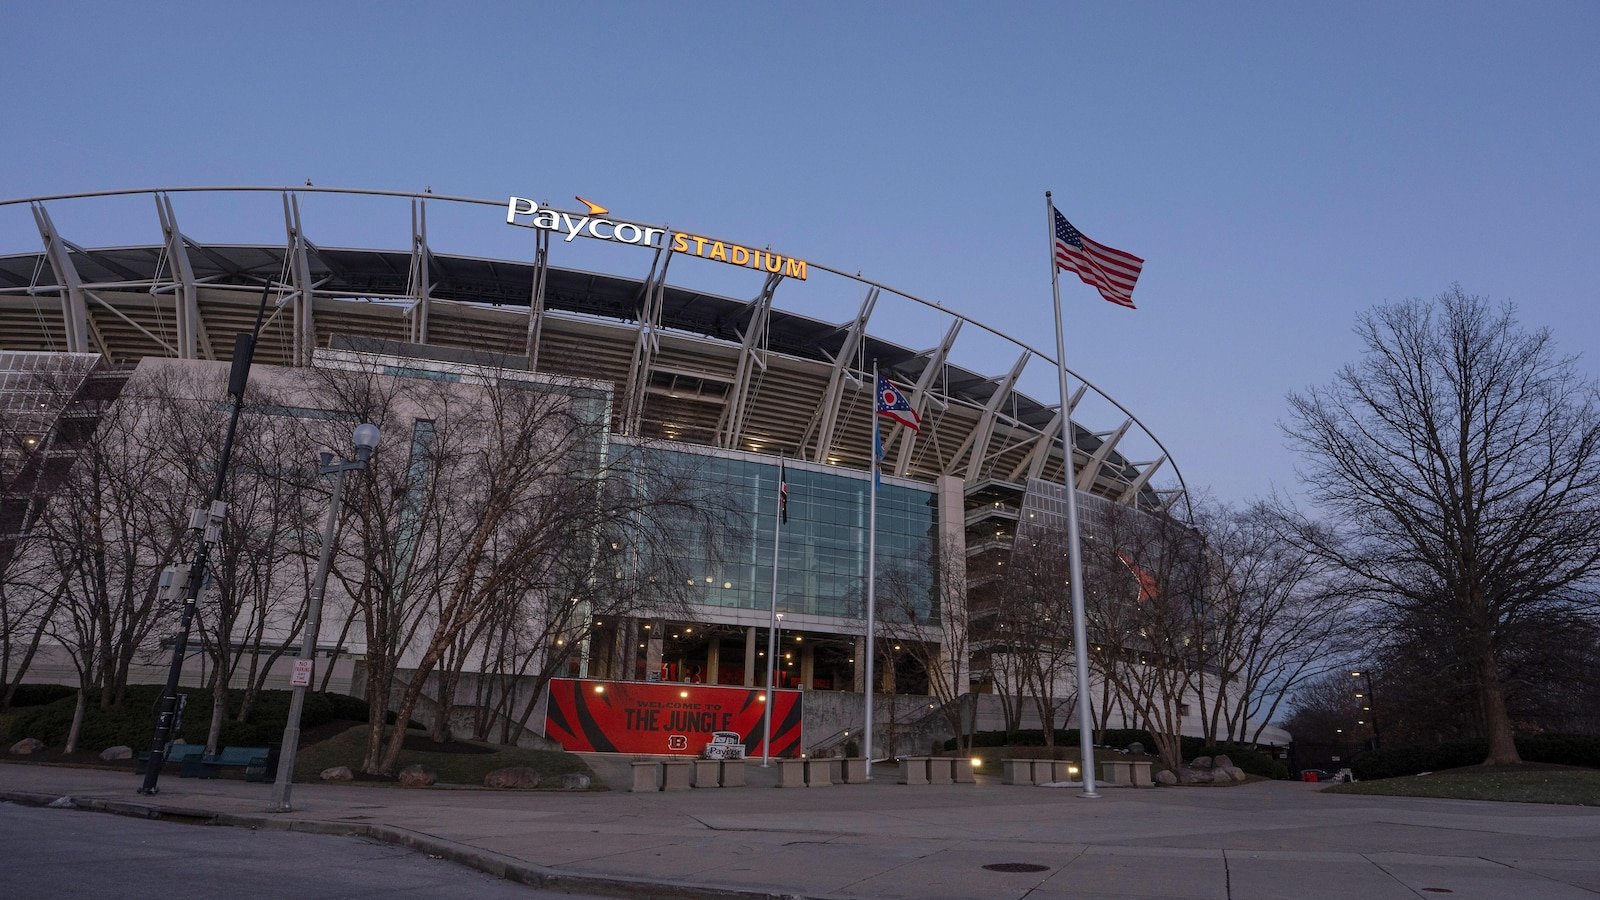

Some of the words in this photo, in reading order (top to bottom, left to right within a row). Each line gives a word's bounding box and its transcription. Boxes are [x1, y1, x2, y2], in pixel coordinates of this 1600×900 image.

[506, 196, 664, 246] Paycor
[673, 231, 807, 280] STADIUM
[626, 709, 660, 732] THE
[663, 711, 732, 732] JUNGLE
